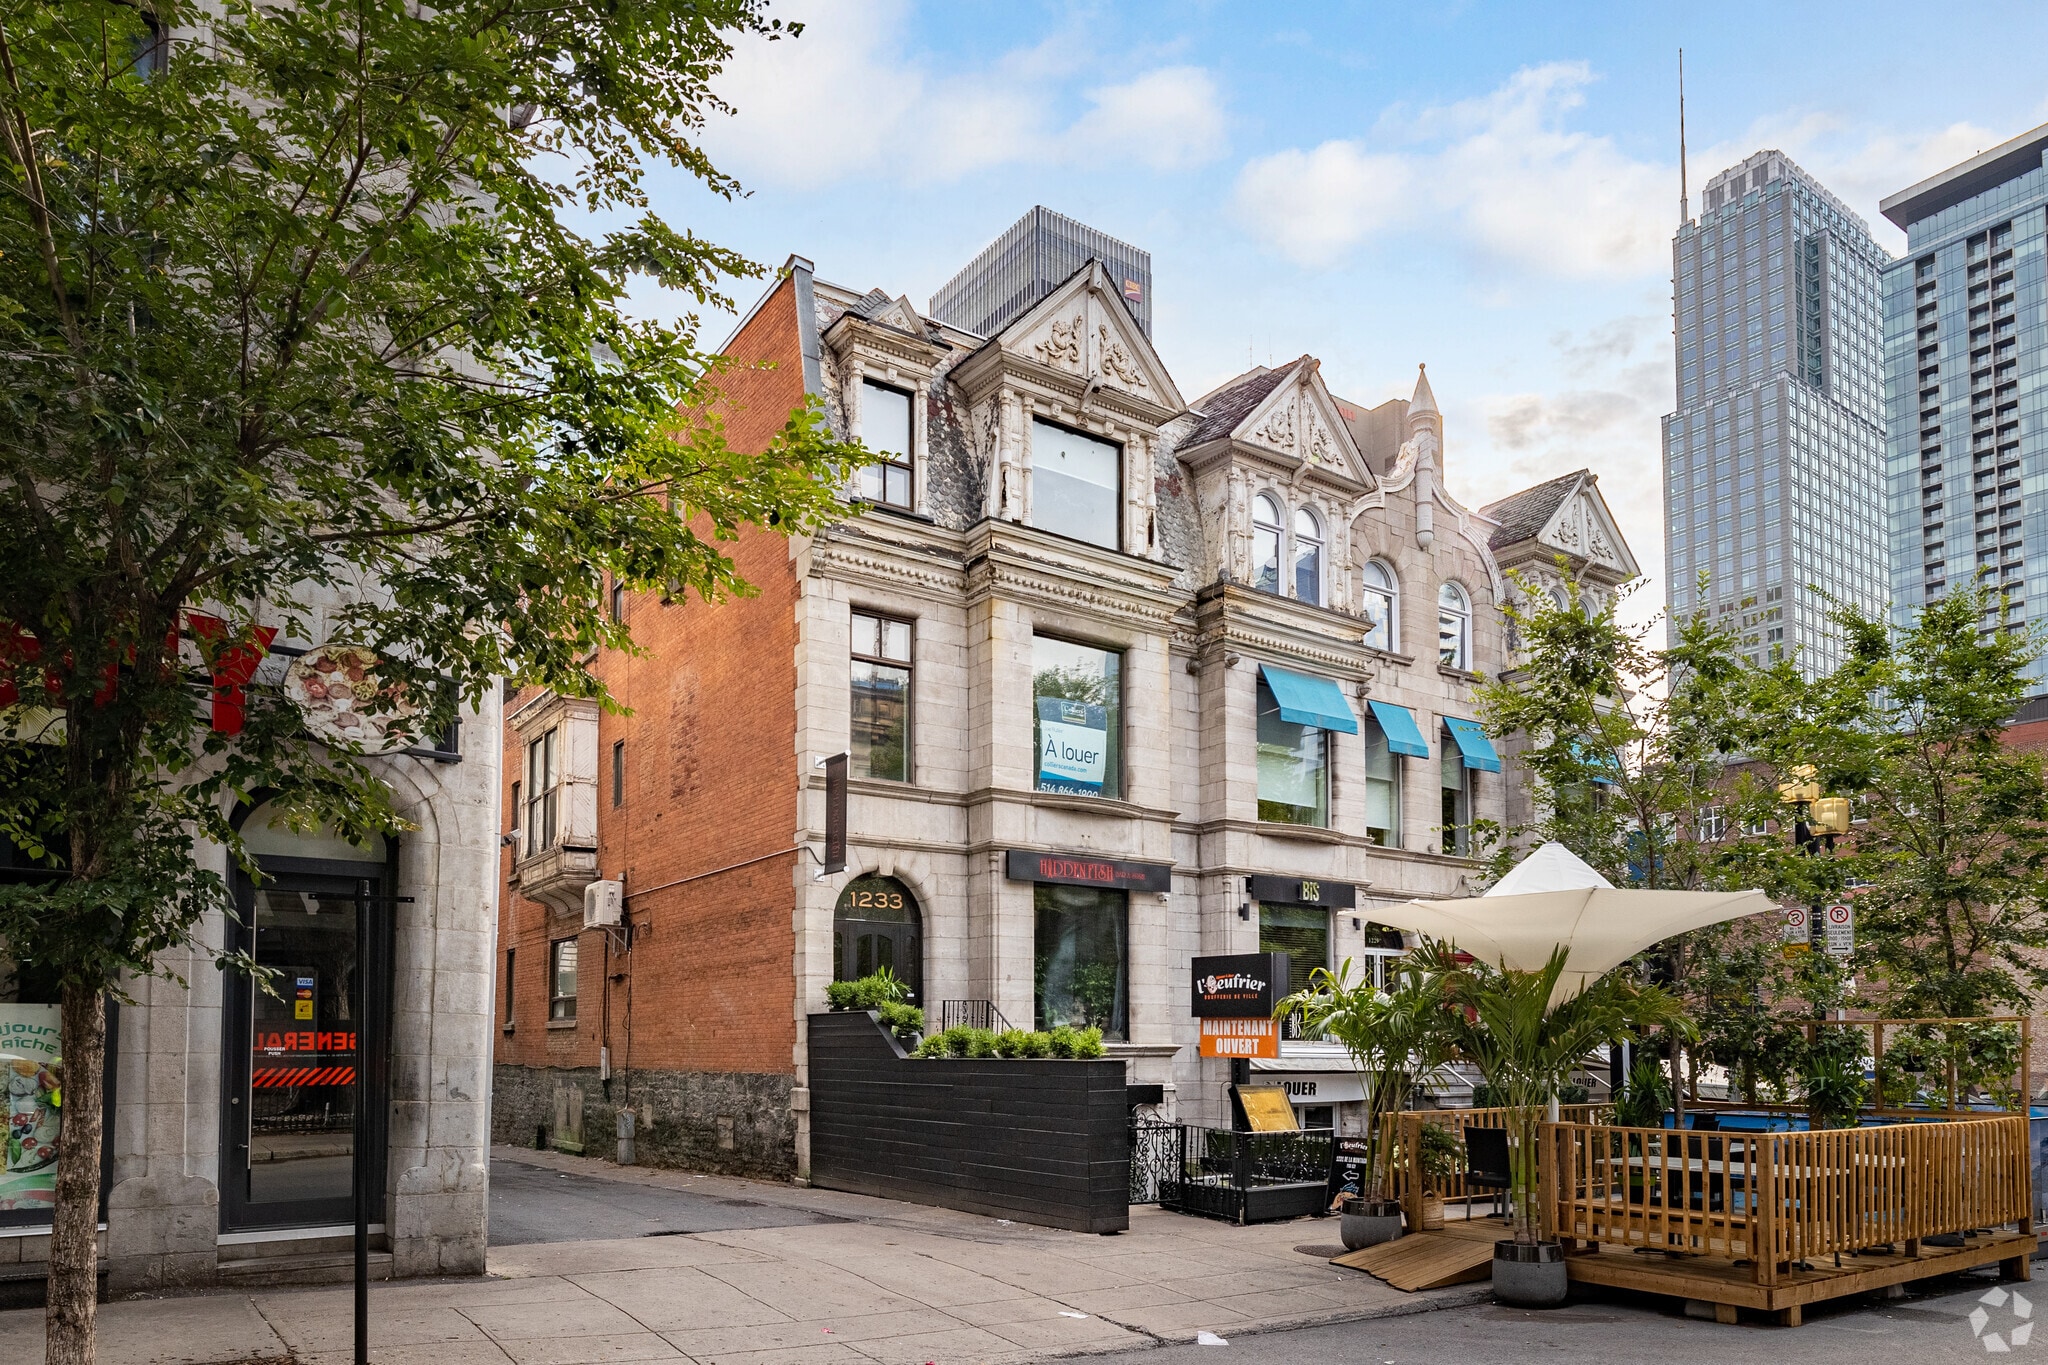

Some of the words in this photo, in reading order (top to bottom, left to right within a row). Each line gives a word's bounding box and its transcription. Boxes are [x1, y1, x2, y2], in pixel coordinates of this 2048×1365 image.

[1044, 733, 1058, 758] À
[1061, 741, 1100, 765] louer
[1043, 761, 1088, 774] collierscanada.com
[1040, 782, 1056, 793] 514
[1087, 863, 1114, 882] FISH
[850, 891, 903, 910] 1233
[1202, 1020, 1274, 1037] MAINTENANT
[1215, 1037, 1260, 1055] OUVERT
[1276, 1081, 1317, 1096] OUER
